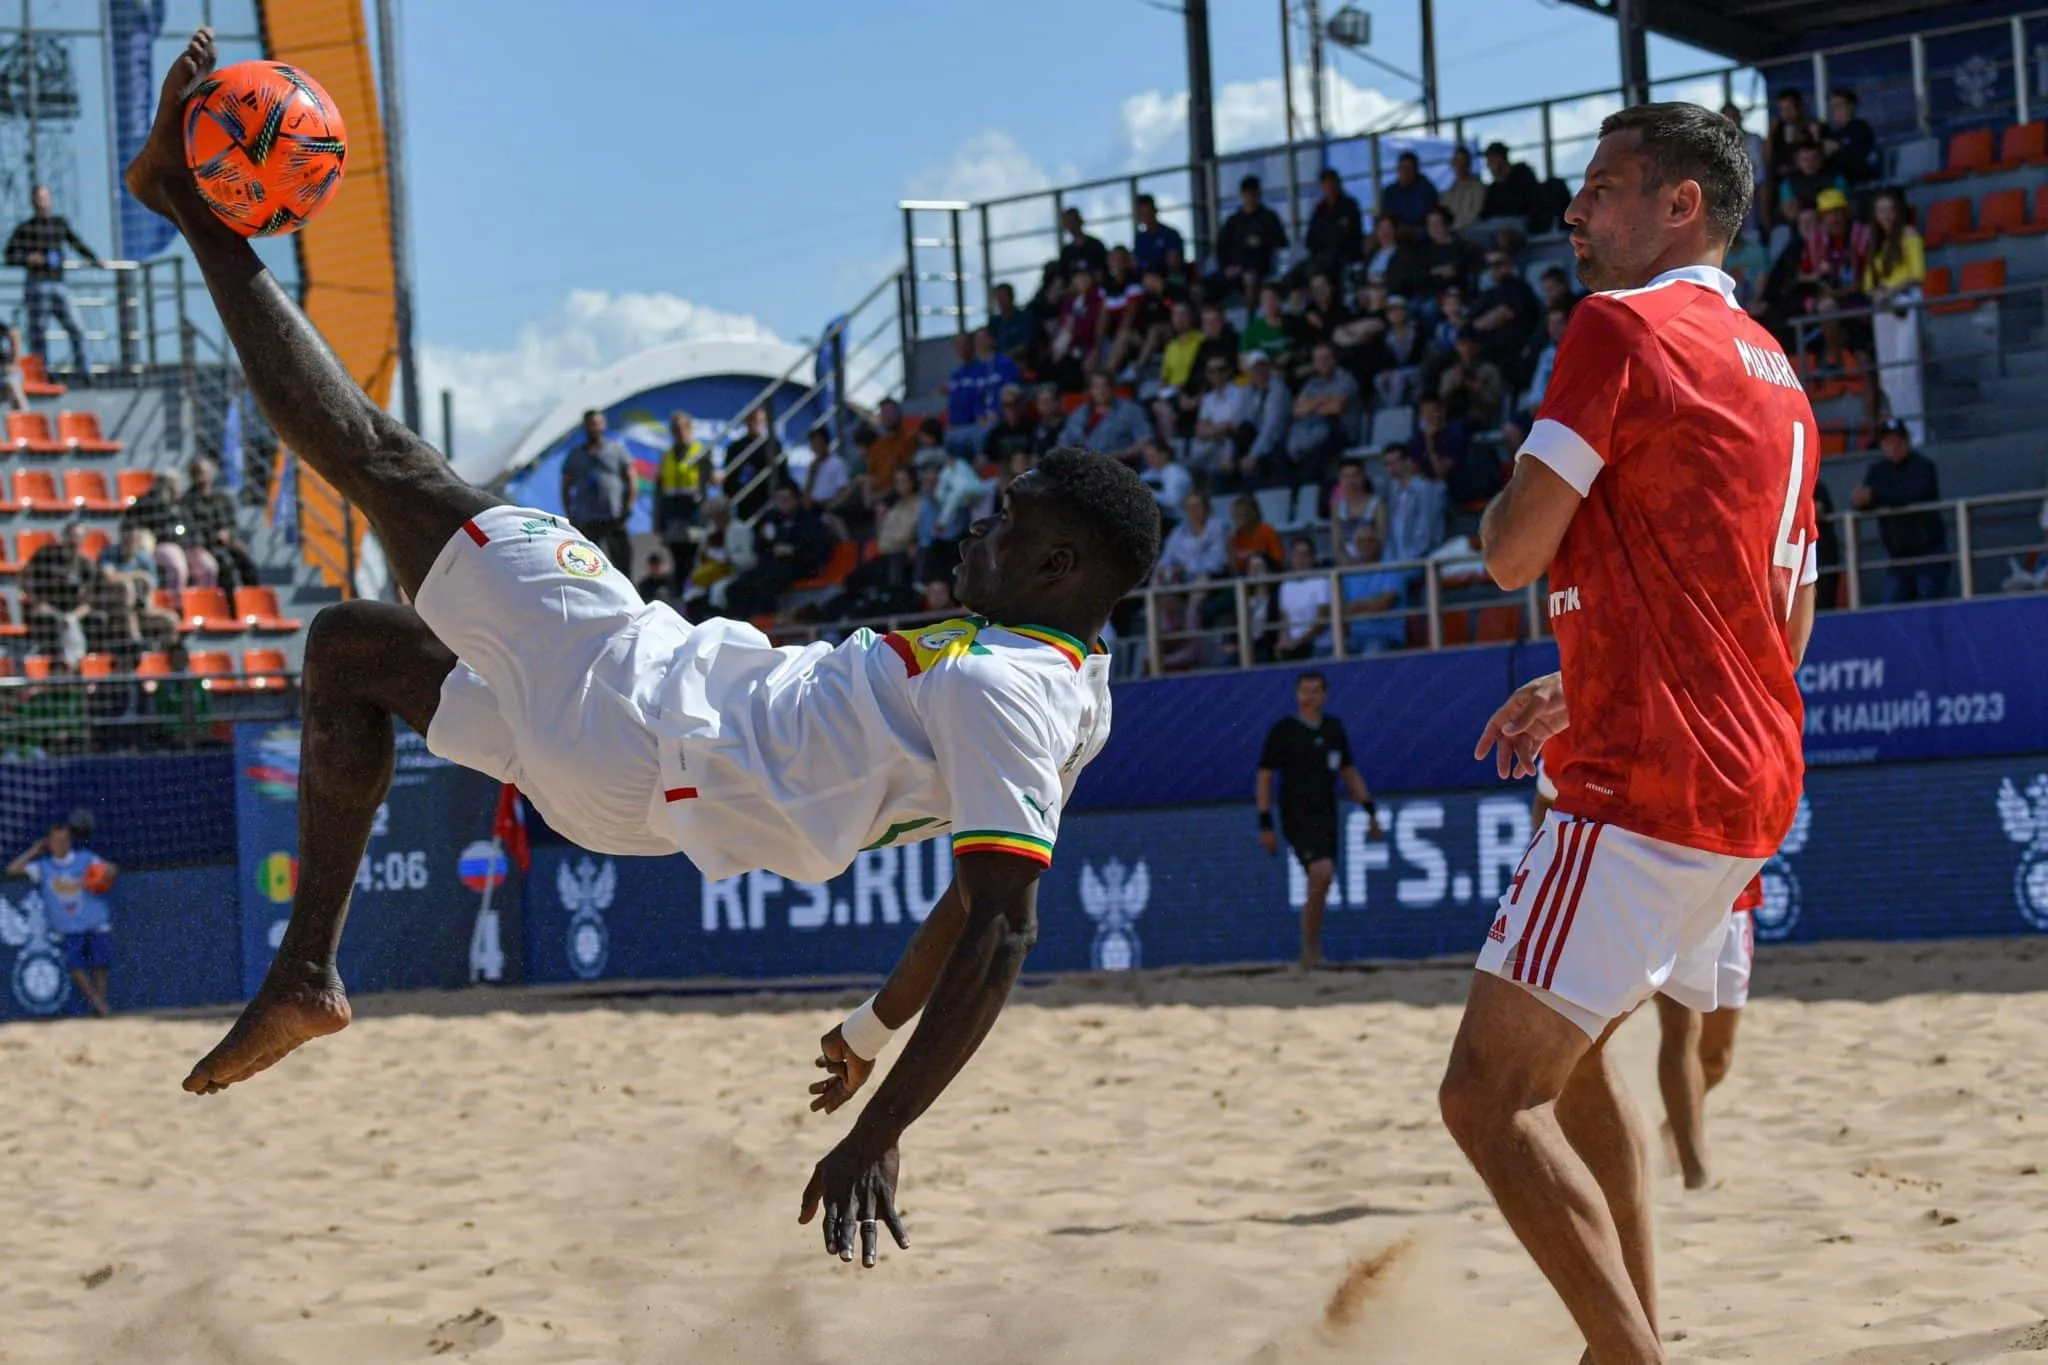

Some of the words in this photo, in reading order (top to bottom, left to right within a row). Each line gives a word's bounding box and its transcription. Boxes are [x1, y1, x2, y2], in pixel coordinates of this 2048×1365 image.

[1772, 420, 1806, 622] 4
[1799, 658, 1885, 693] СИТИ
[1832, 690, 1931, 735] НАЦИЙ
[1937, 692, 2006, 726] 2023
[702, 840, 953, 932] RFS.RU
